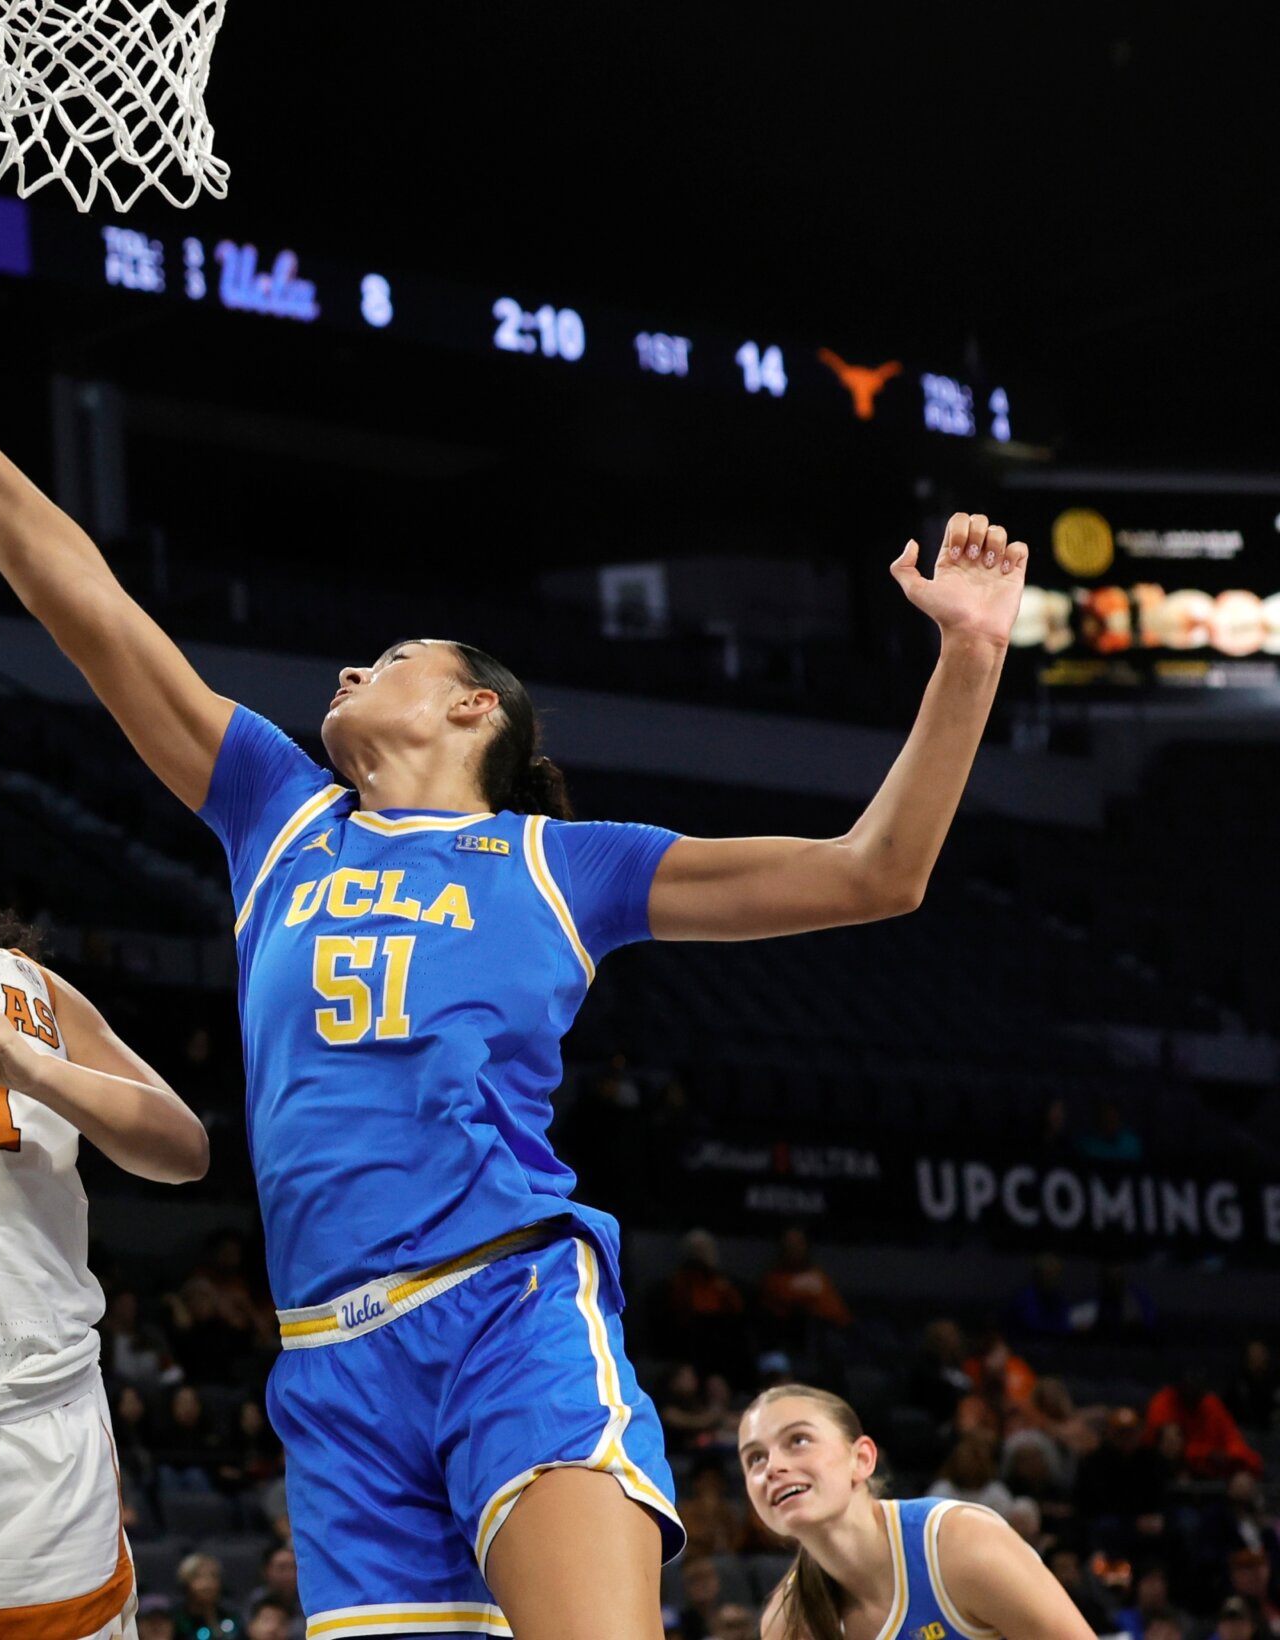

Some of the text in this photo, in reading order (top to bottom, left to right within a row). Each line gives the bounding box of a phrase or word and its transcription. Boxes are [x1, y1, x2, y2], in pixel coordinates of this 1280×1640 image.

[361, 272, 393, 327] 8
[492, 296, 585, 361] 2:10
[735, 339, 788, 397] 14
[284, 867, 475, 931] UCLA
[313, 935, 417, 1046] 51
[913, 1156, 1246, 1243] UPCOMING
[341, 1294, 386, 1329] Ucla
